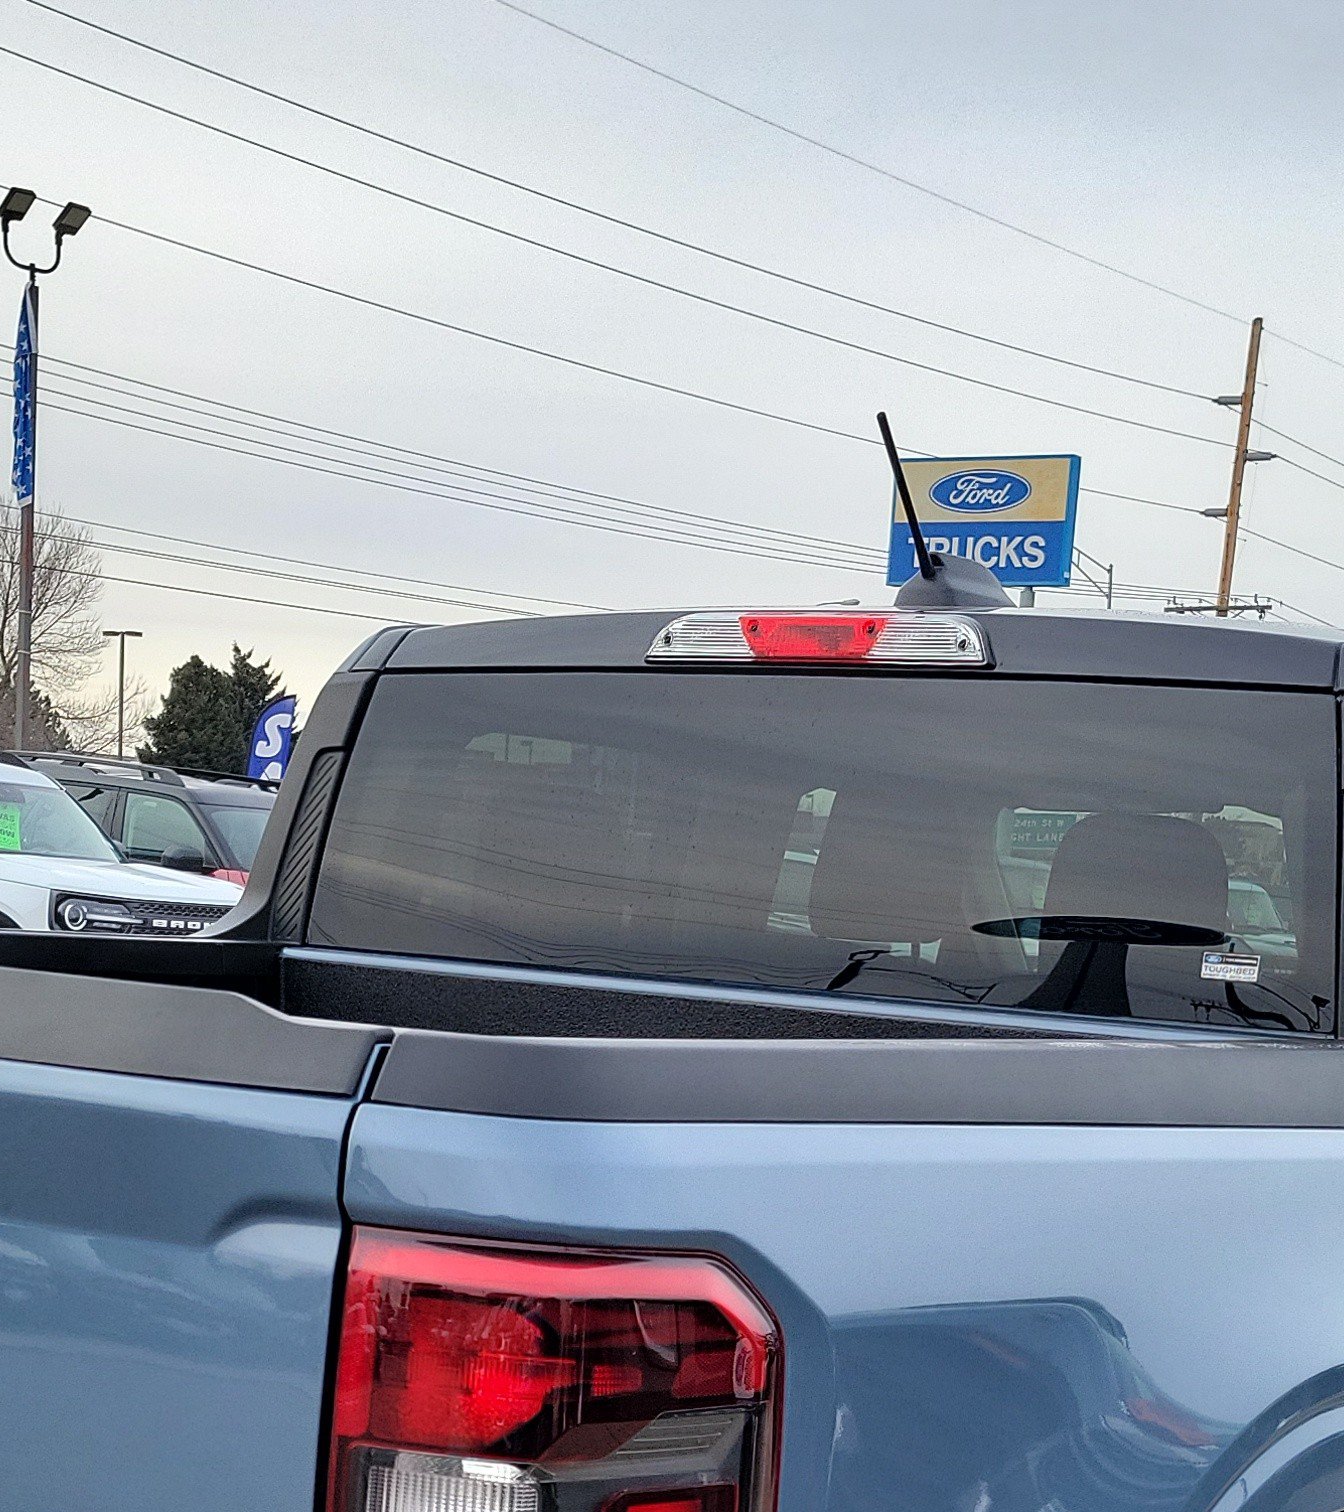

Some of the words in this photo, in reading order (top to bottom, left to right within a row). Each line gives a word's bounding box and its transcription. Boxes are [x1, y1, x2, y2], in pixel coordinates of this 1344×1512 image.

[949, 475, 1012, 505] Ford
[1014, 819, 1036, 828] 24th
[1041, 819, 1051, 828] St
[1037, 832, 1065, 842] LANE
